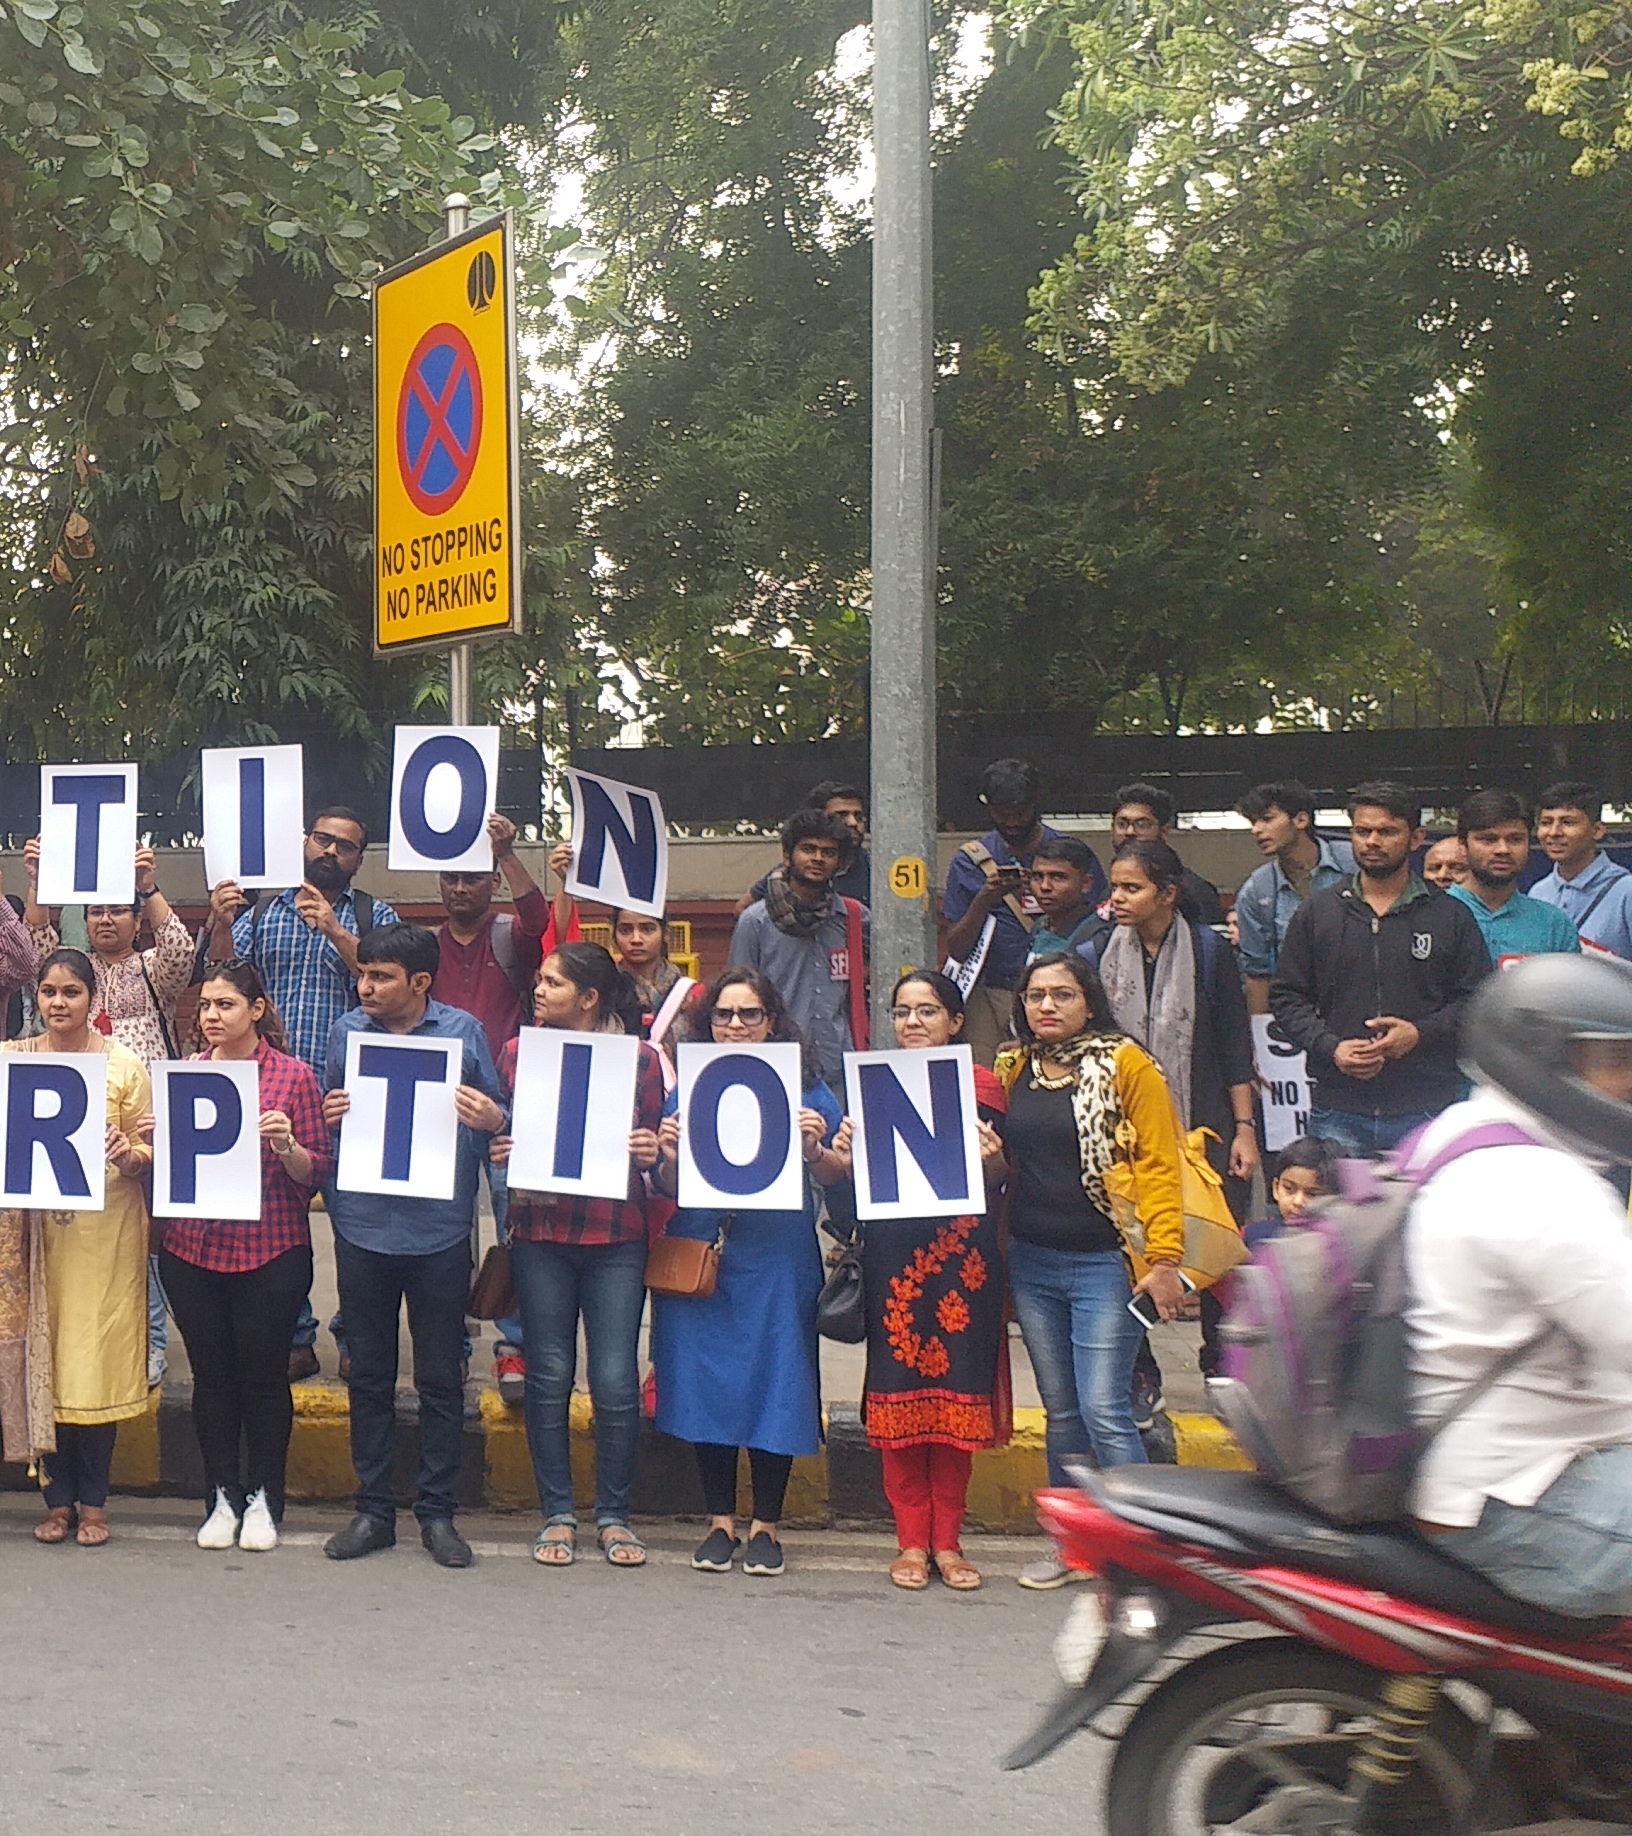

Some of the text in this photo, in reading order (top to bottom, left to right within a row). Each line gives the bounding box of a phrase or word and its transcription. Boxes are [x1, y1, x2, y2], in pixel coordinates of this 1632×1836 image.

[382, 517, 502, 578] NO STOPPING
[387, 568, 496, 622] NO PARKING
[52, 775, 125, 891] T
[239, 758, 265, 876] I
[400, 736, 487, 860] O
[576, 775, 657, 903] N
[894, 864, 920, 888] 51
[5, 1064, 91, 1196] R
[167, 1072, 242, 1203] P
[359, 1045, 448, 1181] T
[554, 1043, 592, 1179] I
[689, 1054, 790, 1194] O
[858, 1059, 968, 1203] N
[1270, 1080, 1299, 1106] NO
